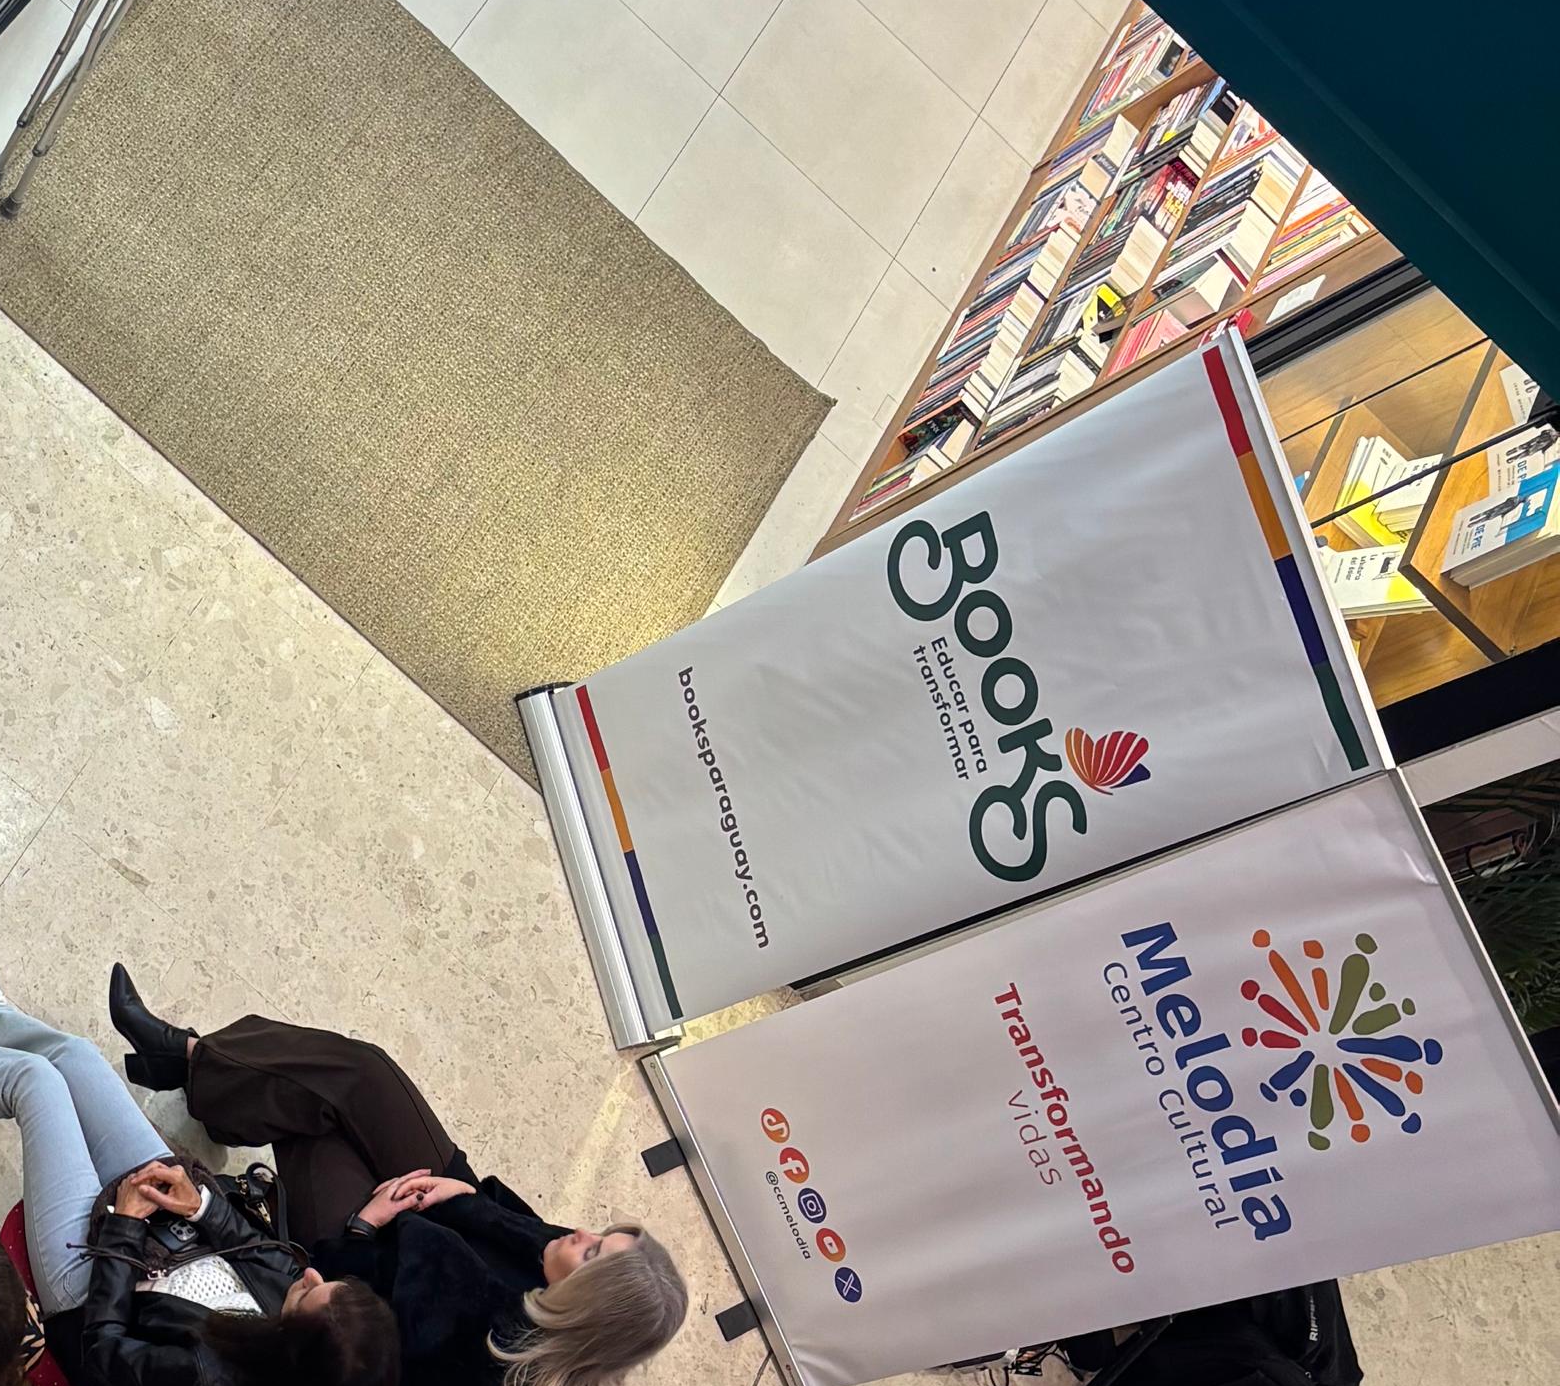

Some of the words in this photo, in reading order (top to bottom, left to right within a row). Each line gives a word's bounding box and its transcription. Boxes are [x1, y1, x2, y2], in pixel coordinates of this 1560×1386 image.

[912, 645, 970, 781] transformar
[930, 636, 970, 714] Educar
[958, 714, 987, 774] para
[678, 666, 769, 949] booksparaguay.com
[994, 982, 1135, 1274] Transformando
[1008, 1090, 1062, 1186] vidas
[1103, 962, 1165, 1076] Centro
[1158, 1089, 1240, 1229] Cultural
[1120, 921, 1292, 1241] Melodía
[765, 1171, 811, 1260] @ccmelodia
